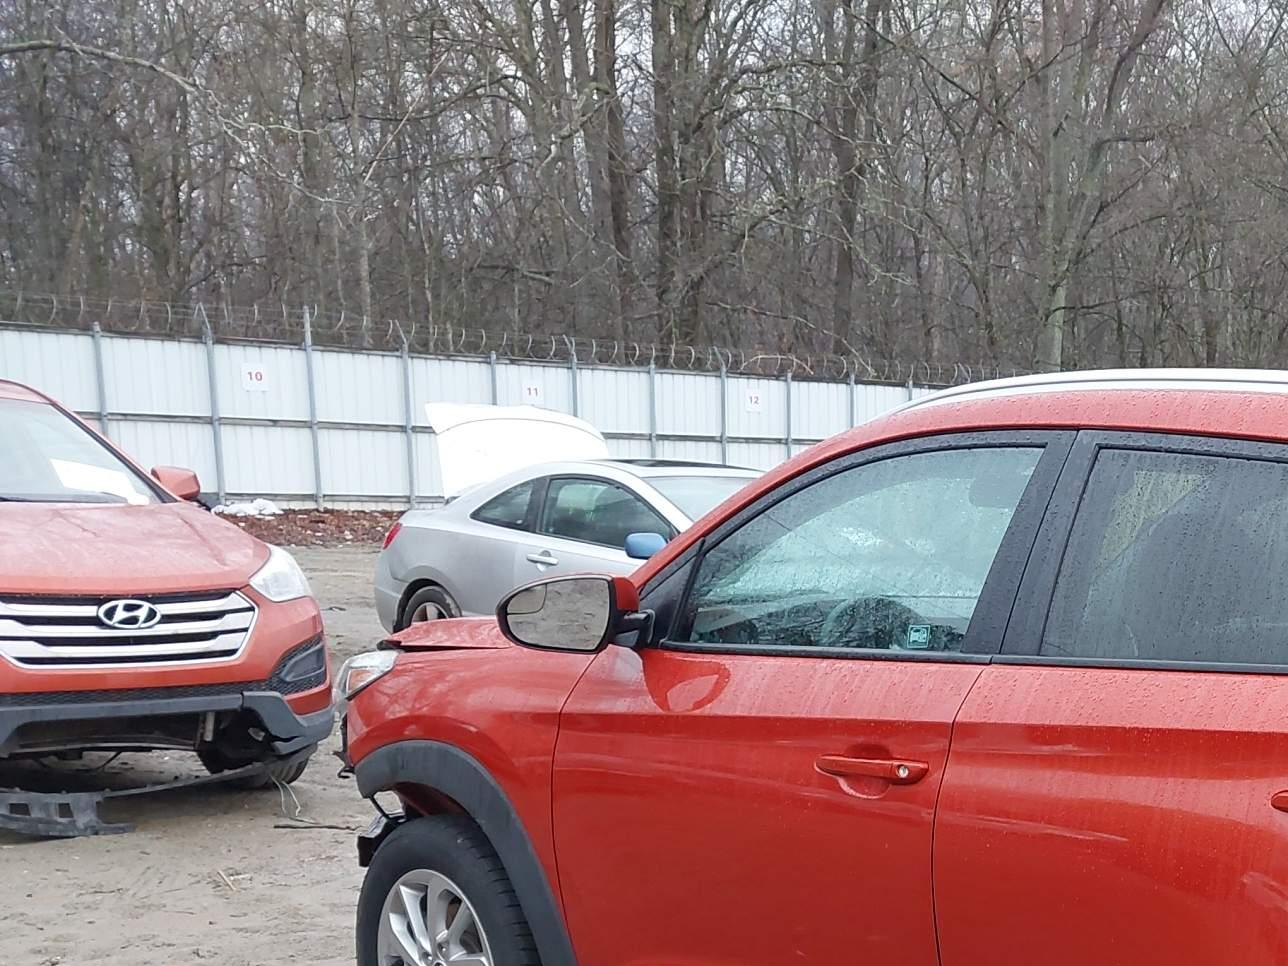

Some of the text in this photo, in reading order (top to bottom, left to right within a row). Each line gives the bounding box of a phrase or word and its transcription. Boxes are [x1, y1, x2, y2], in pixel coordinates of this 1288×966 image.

[247, 371, 263, 381] 10
[527, 387, 538, 397] 11
[750, 396, 760, 405] 12
